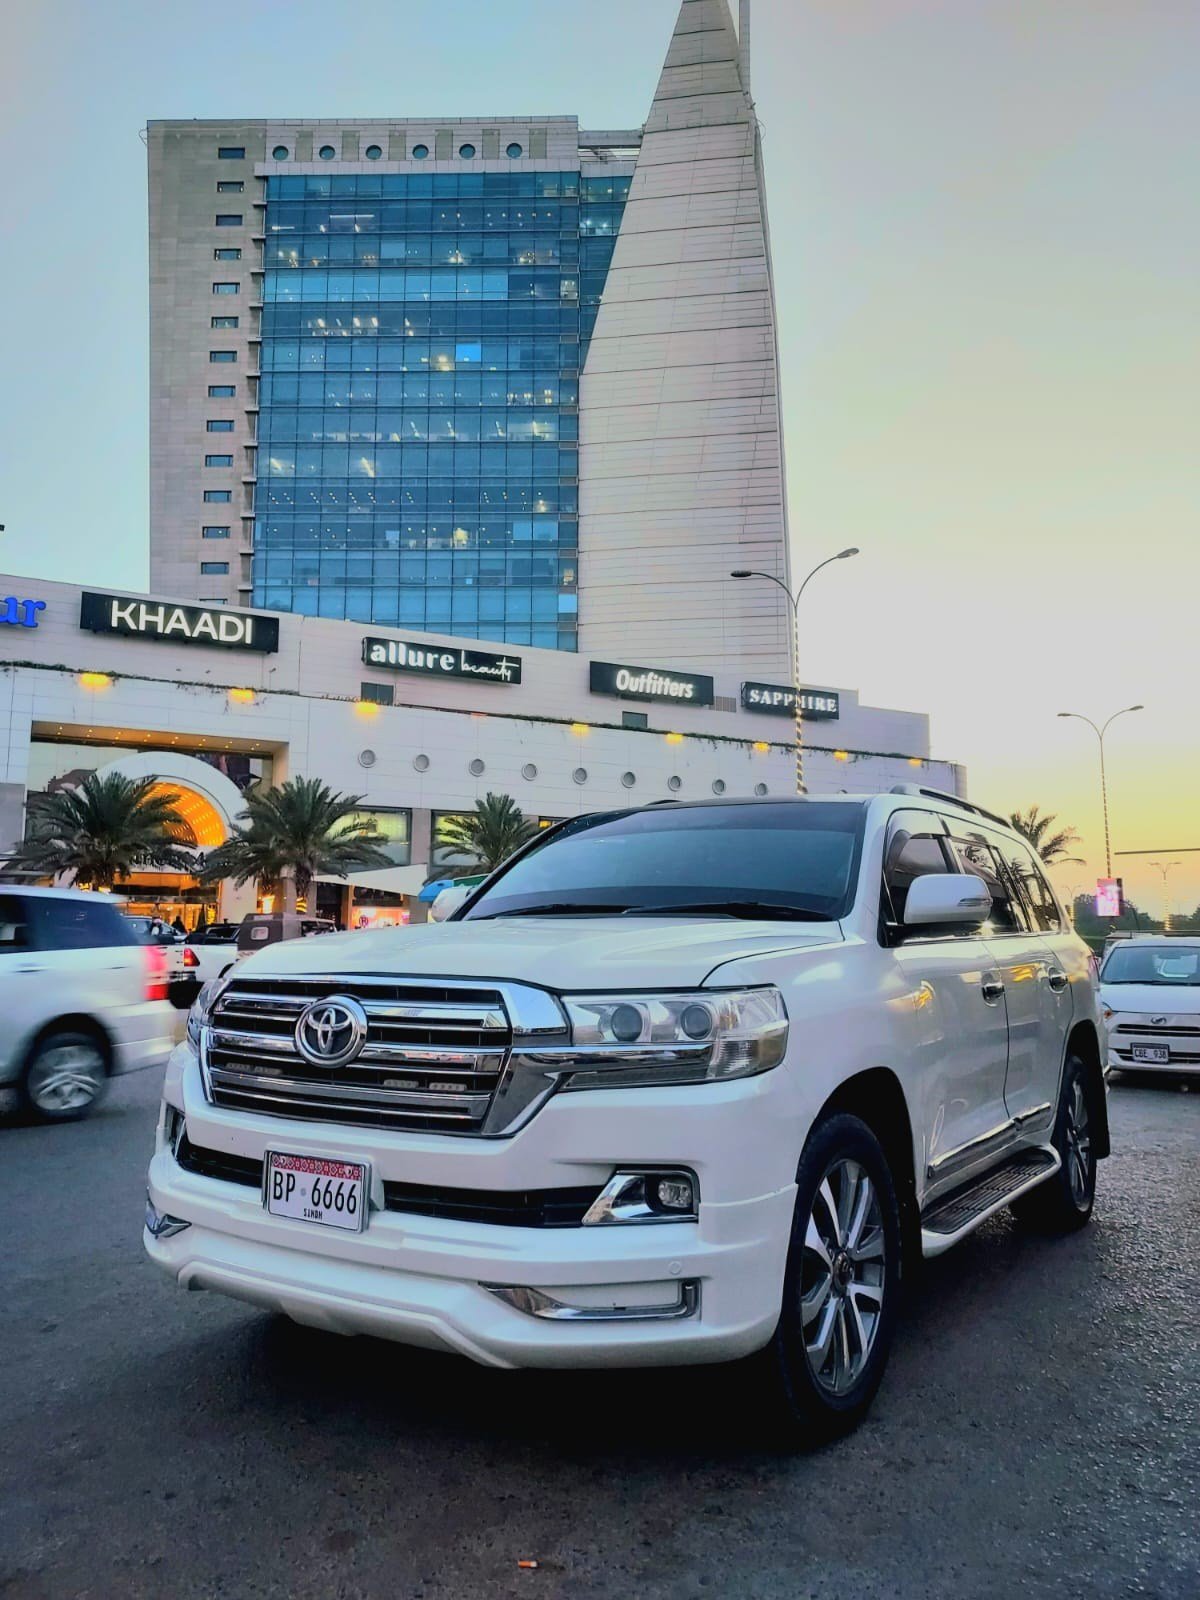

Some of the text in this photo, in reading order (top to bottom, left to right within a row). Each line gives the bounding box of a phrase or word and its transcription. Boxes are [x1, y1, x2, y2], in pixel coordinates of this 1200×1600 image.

[111, 600, 253, 644] KHAADI
[370, 641, 519, 681] allure beauty
[615, 669, 693, 698] Outfitters
[749, 690, 836, 713] SAPPHIRE
[272, 1170, 357, 1214] BP 6666
[303, 1208, 323, 1220] SINDH
